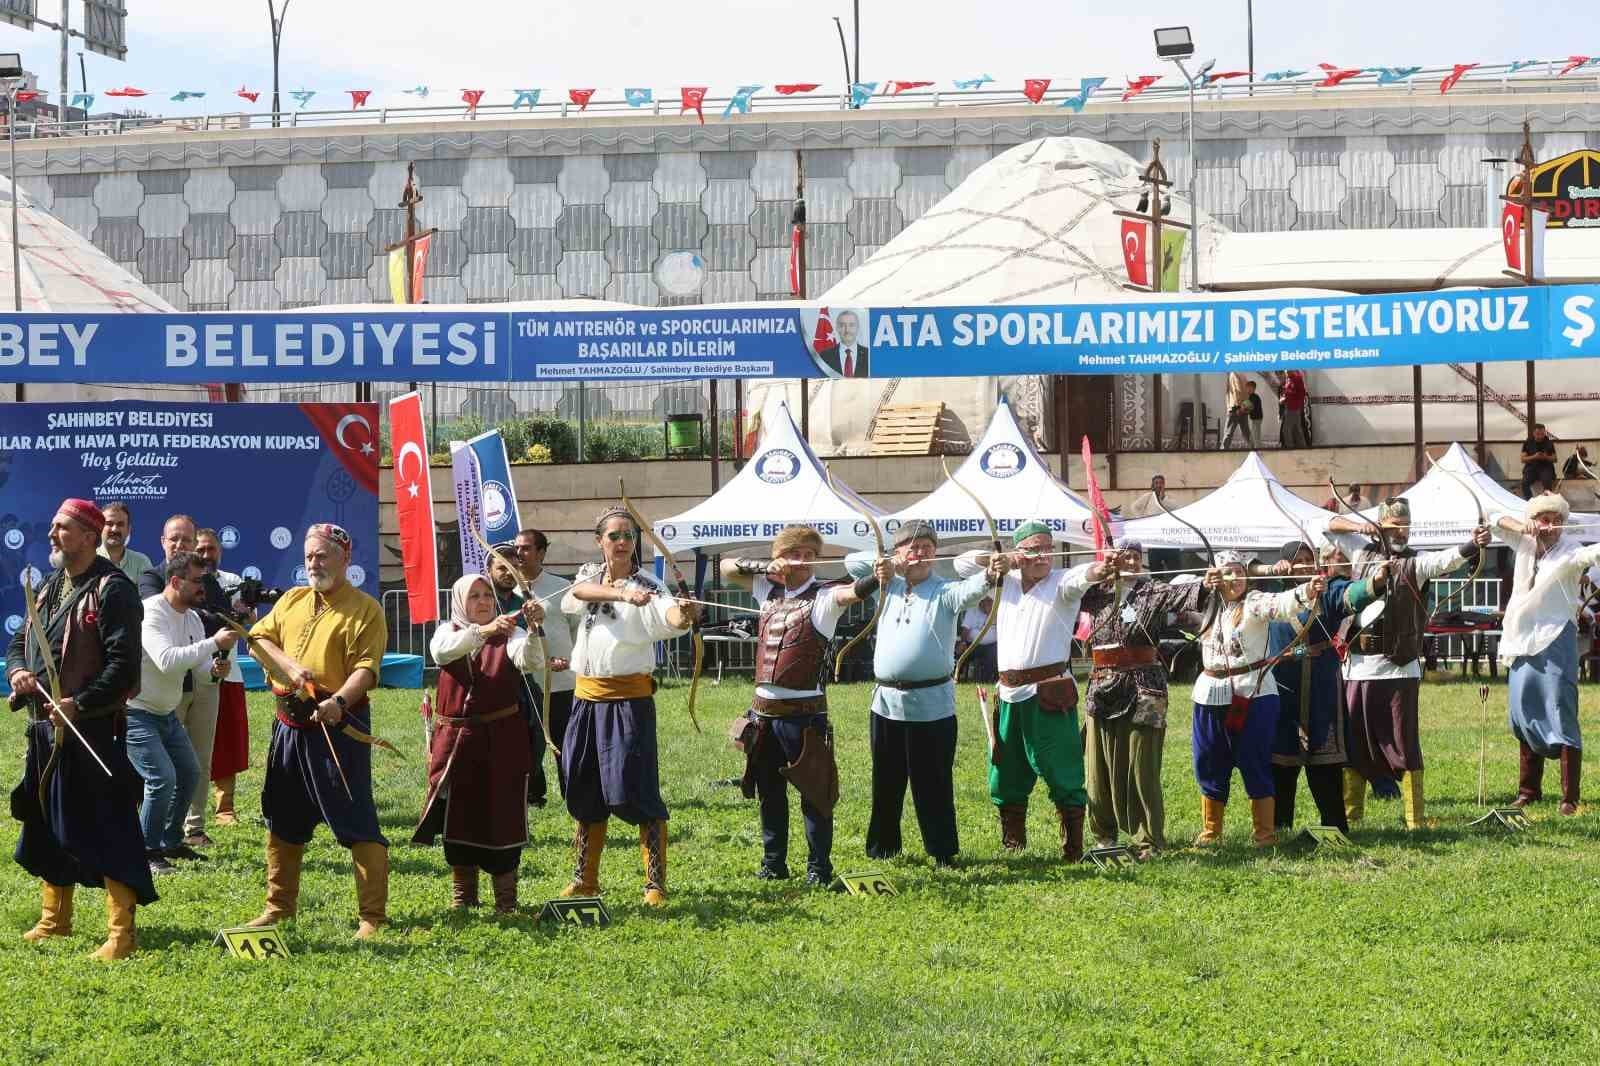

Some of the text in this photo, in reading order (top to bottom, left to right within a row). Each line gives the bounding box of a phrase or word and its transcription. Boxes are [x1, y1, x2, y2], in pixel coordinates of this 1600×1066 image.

[517, 317, 797, 337] TÜM ANTRENÖR ve SPORCULARIMIZA
[872, 313, 943, 347] ATA
[952, 308, 1215, 347] SPORLARIMIZI
[1562, 295, 1596, 348] Ş
[578, 338, 736, 360] BAŞARILAR DİLERİM
[1079, 353, 1125, 366] Mehmet
[1128, 351, 1211, 365] TAHMAZOĞLU
[1224, 351, 1278, 366] Şahinbey
[1281, 349, 1331, 363] Belediye
[1334, 347, 1380, 361] Başkanı
[540, 366, 576, 376] Mehmet
[578, 364, 641, 376] TAHMAZOĞLU
[650, 365, 692, 377] Şahinbey
[694, 364, 734, 375] Belediye
[35, 435, 71, 451] AÇIK
[75, 434, 116, 449] HAVA
[119, 433, 158, 448] PUTA
[163, 434, 261, 449] FEDERASYON
[265, 435, 320, 450] KUPASI
[80, 451, 179, 471] Hoş Geldiniz
[565, 907, 601, 925] 17
[239, 937, 281, 959] 18
